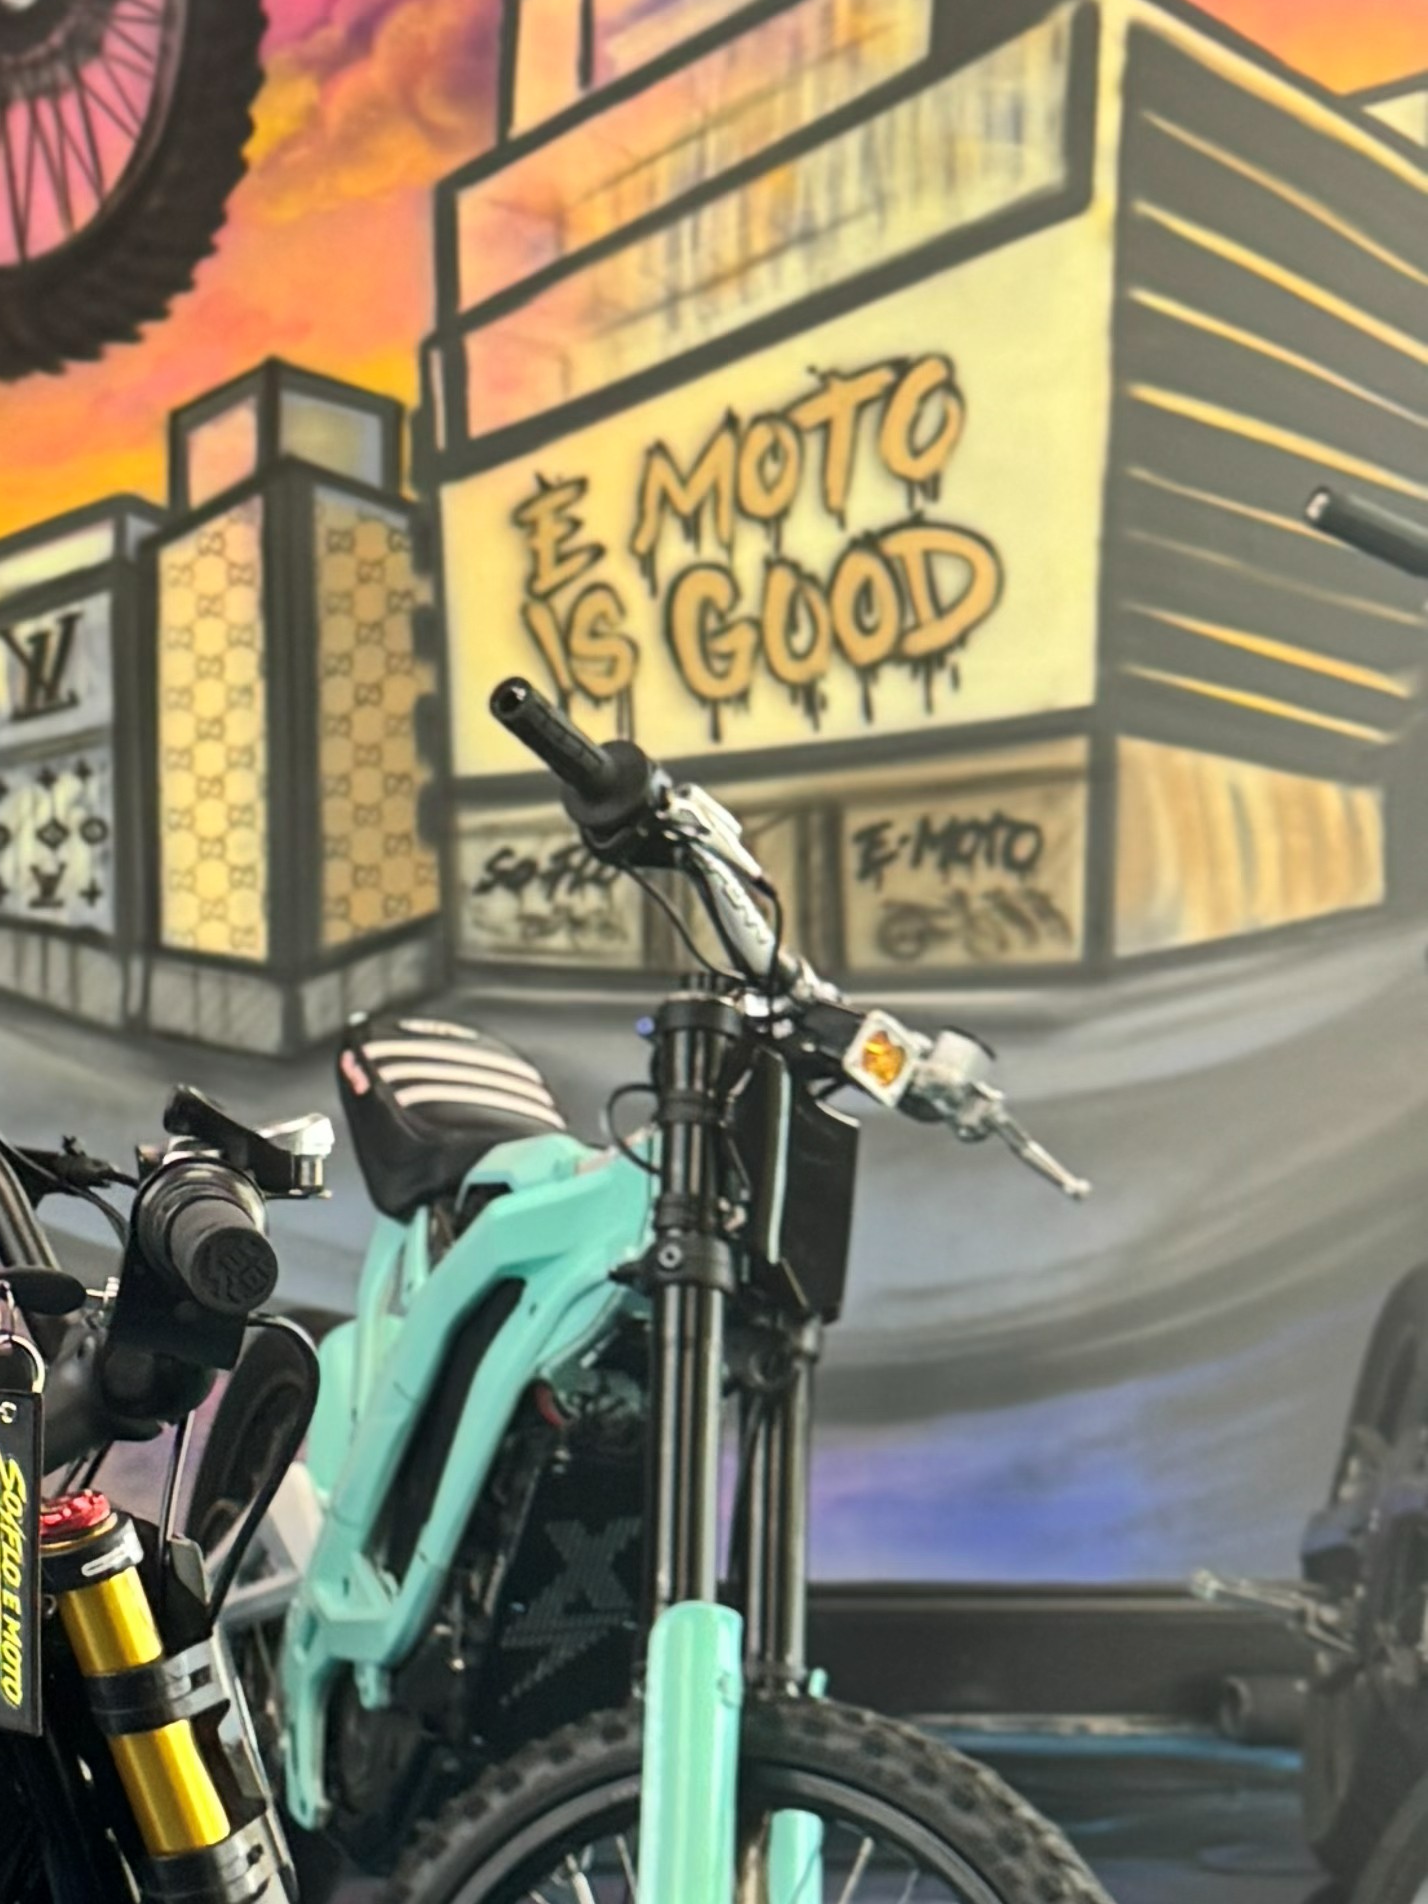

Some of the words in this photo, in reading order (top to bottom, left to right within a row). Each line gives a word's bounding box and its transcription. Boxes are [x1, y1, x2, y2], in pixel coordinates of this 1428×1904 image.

[512, 471, 605, 598] E
[632, 353, 967, 566] MOTO
[521, 582, 639, 704] IS
[666, 514, 1005, 706] GOOD
[1, 1618, 24, 1710] MOTO
